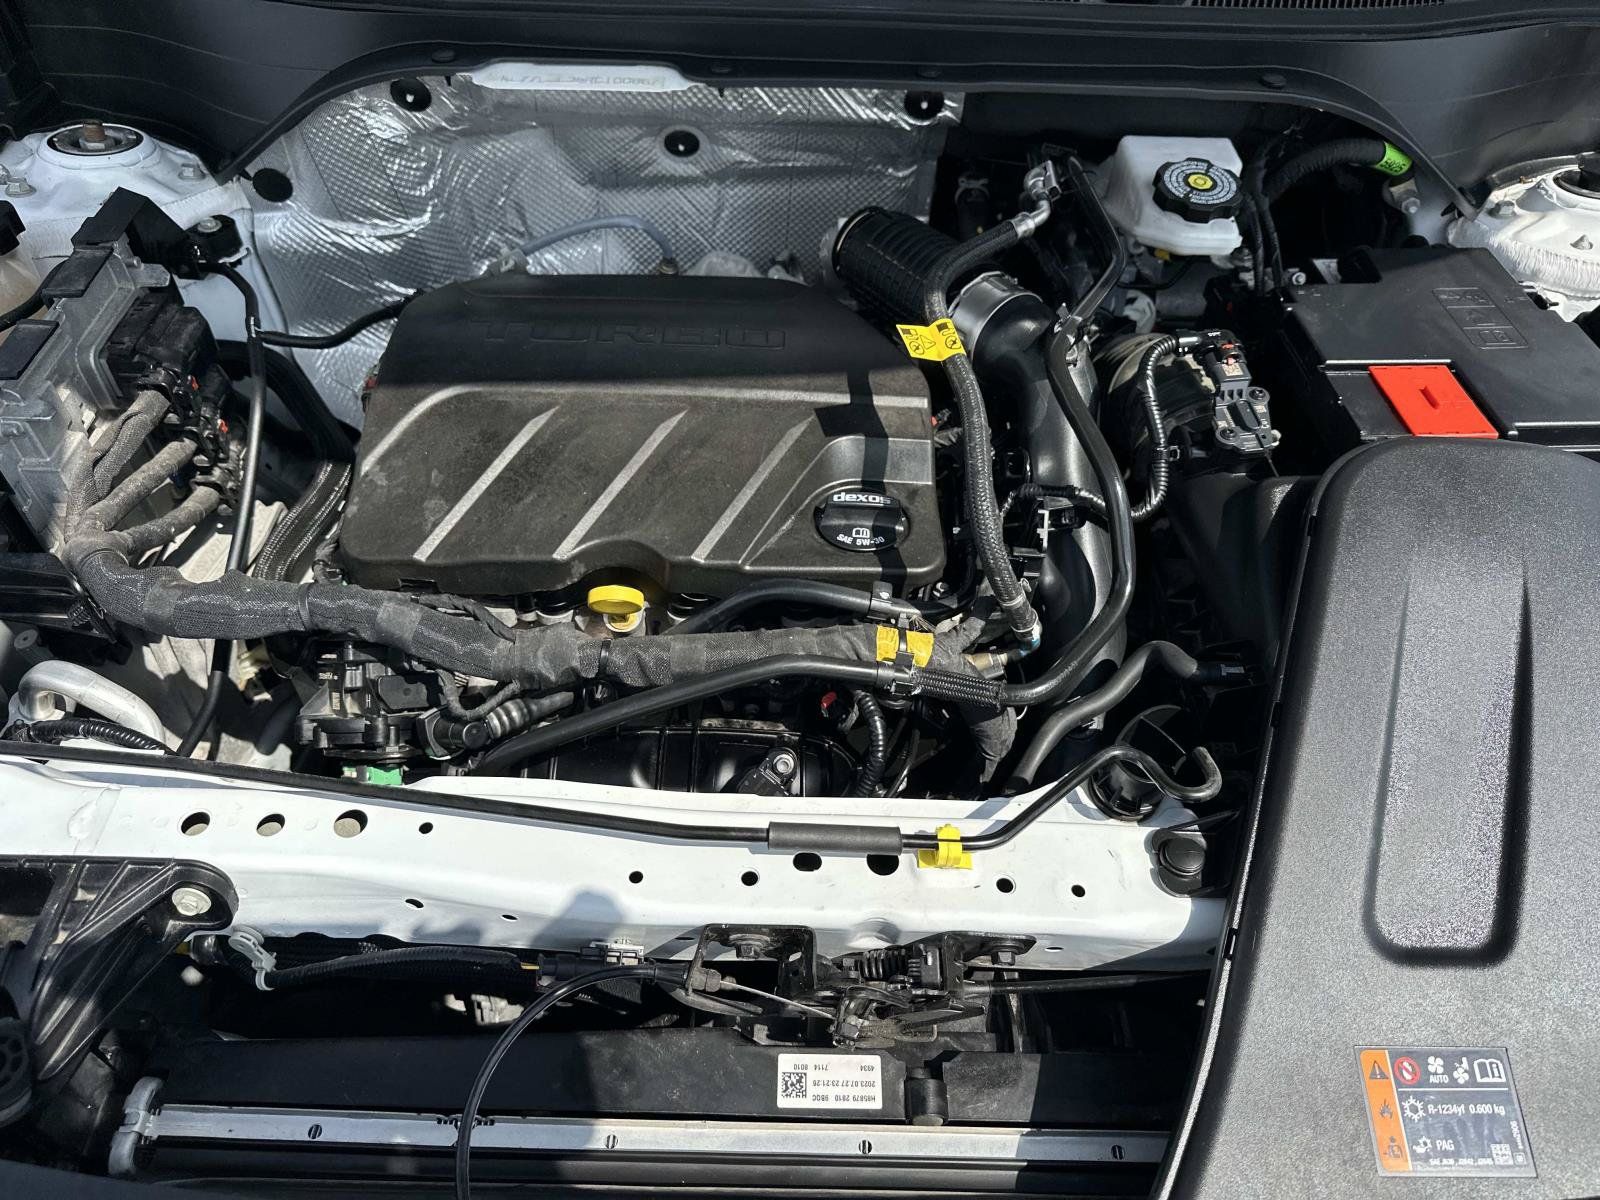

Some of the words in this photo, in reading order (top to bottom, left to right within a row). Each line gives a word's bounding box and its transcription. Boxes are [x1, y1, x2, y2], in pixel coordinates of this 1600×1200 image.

[470, 321, 786, 350] TURBO
[833, 492, 891, 504] dexos
[837, 534, 853, 544] SAE
[856, 536, 885, 545] 5W-30
[1429, 1075, 1449, 1083] AUTO
[1427, 1104, 1465, 1116] R-1234yf
[1468, 1104, 1493, 1115] 0.600
[1494, 1104, 1505, 1116] kg
[1436, 1140, 1455, 1151] PAG
